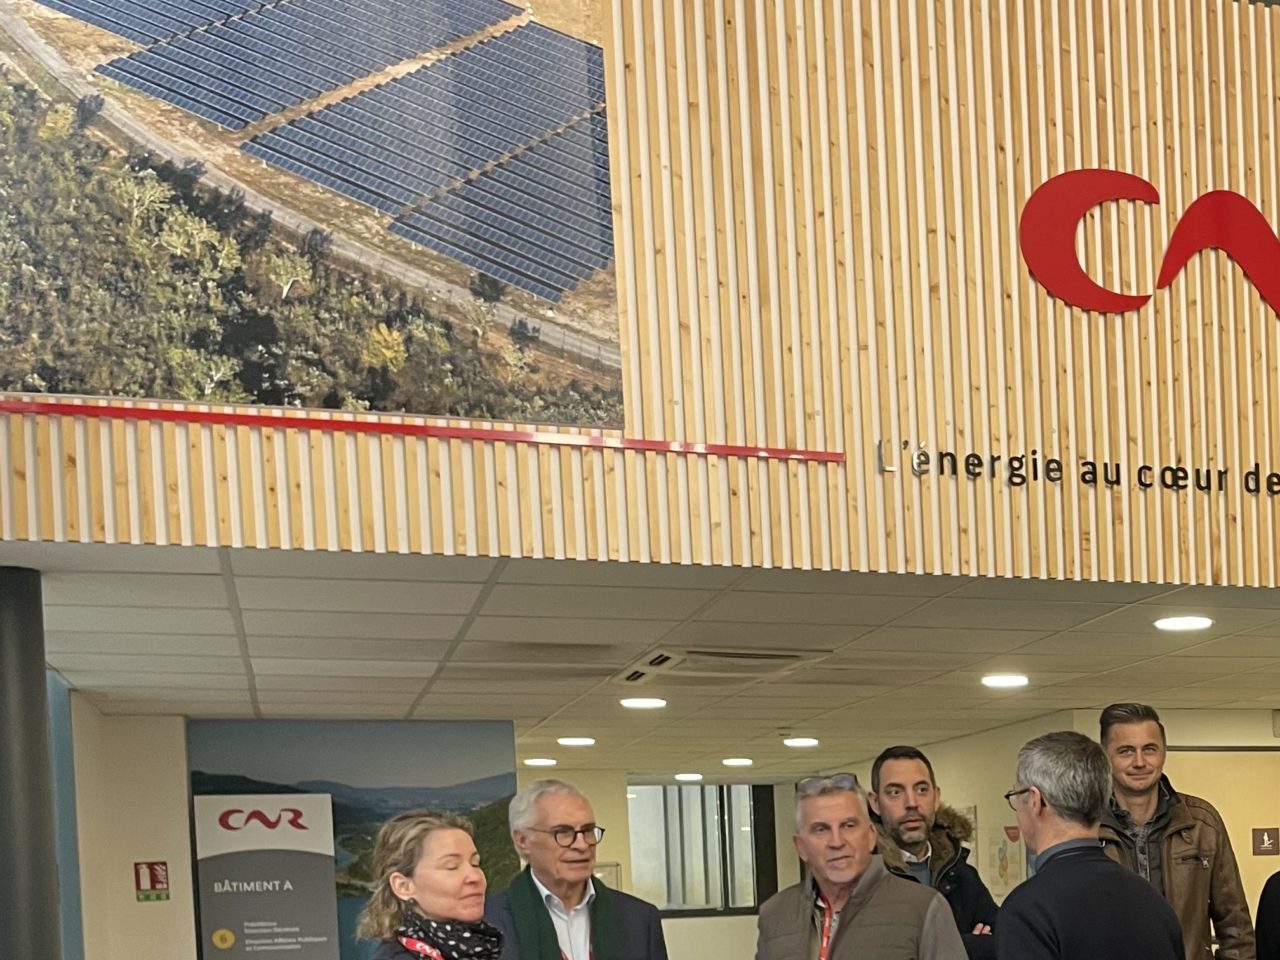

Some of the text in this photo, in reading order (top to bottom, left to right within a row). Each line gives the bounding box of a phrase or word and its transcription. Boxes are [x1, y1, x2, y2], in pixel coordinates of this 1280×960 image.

[877, 438, 1064, 487] L'énergie
[1080, 457, 1122, 487] au
[1137, 462, 1229, 493] cœur
[218, 808, 310, 831] CNR
[213, 879, 294, 893] BÂTIMENT A
